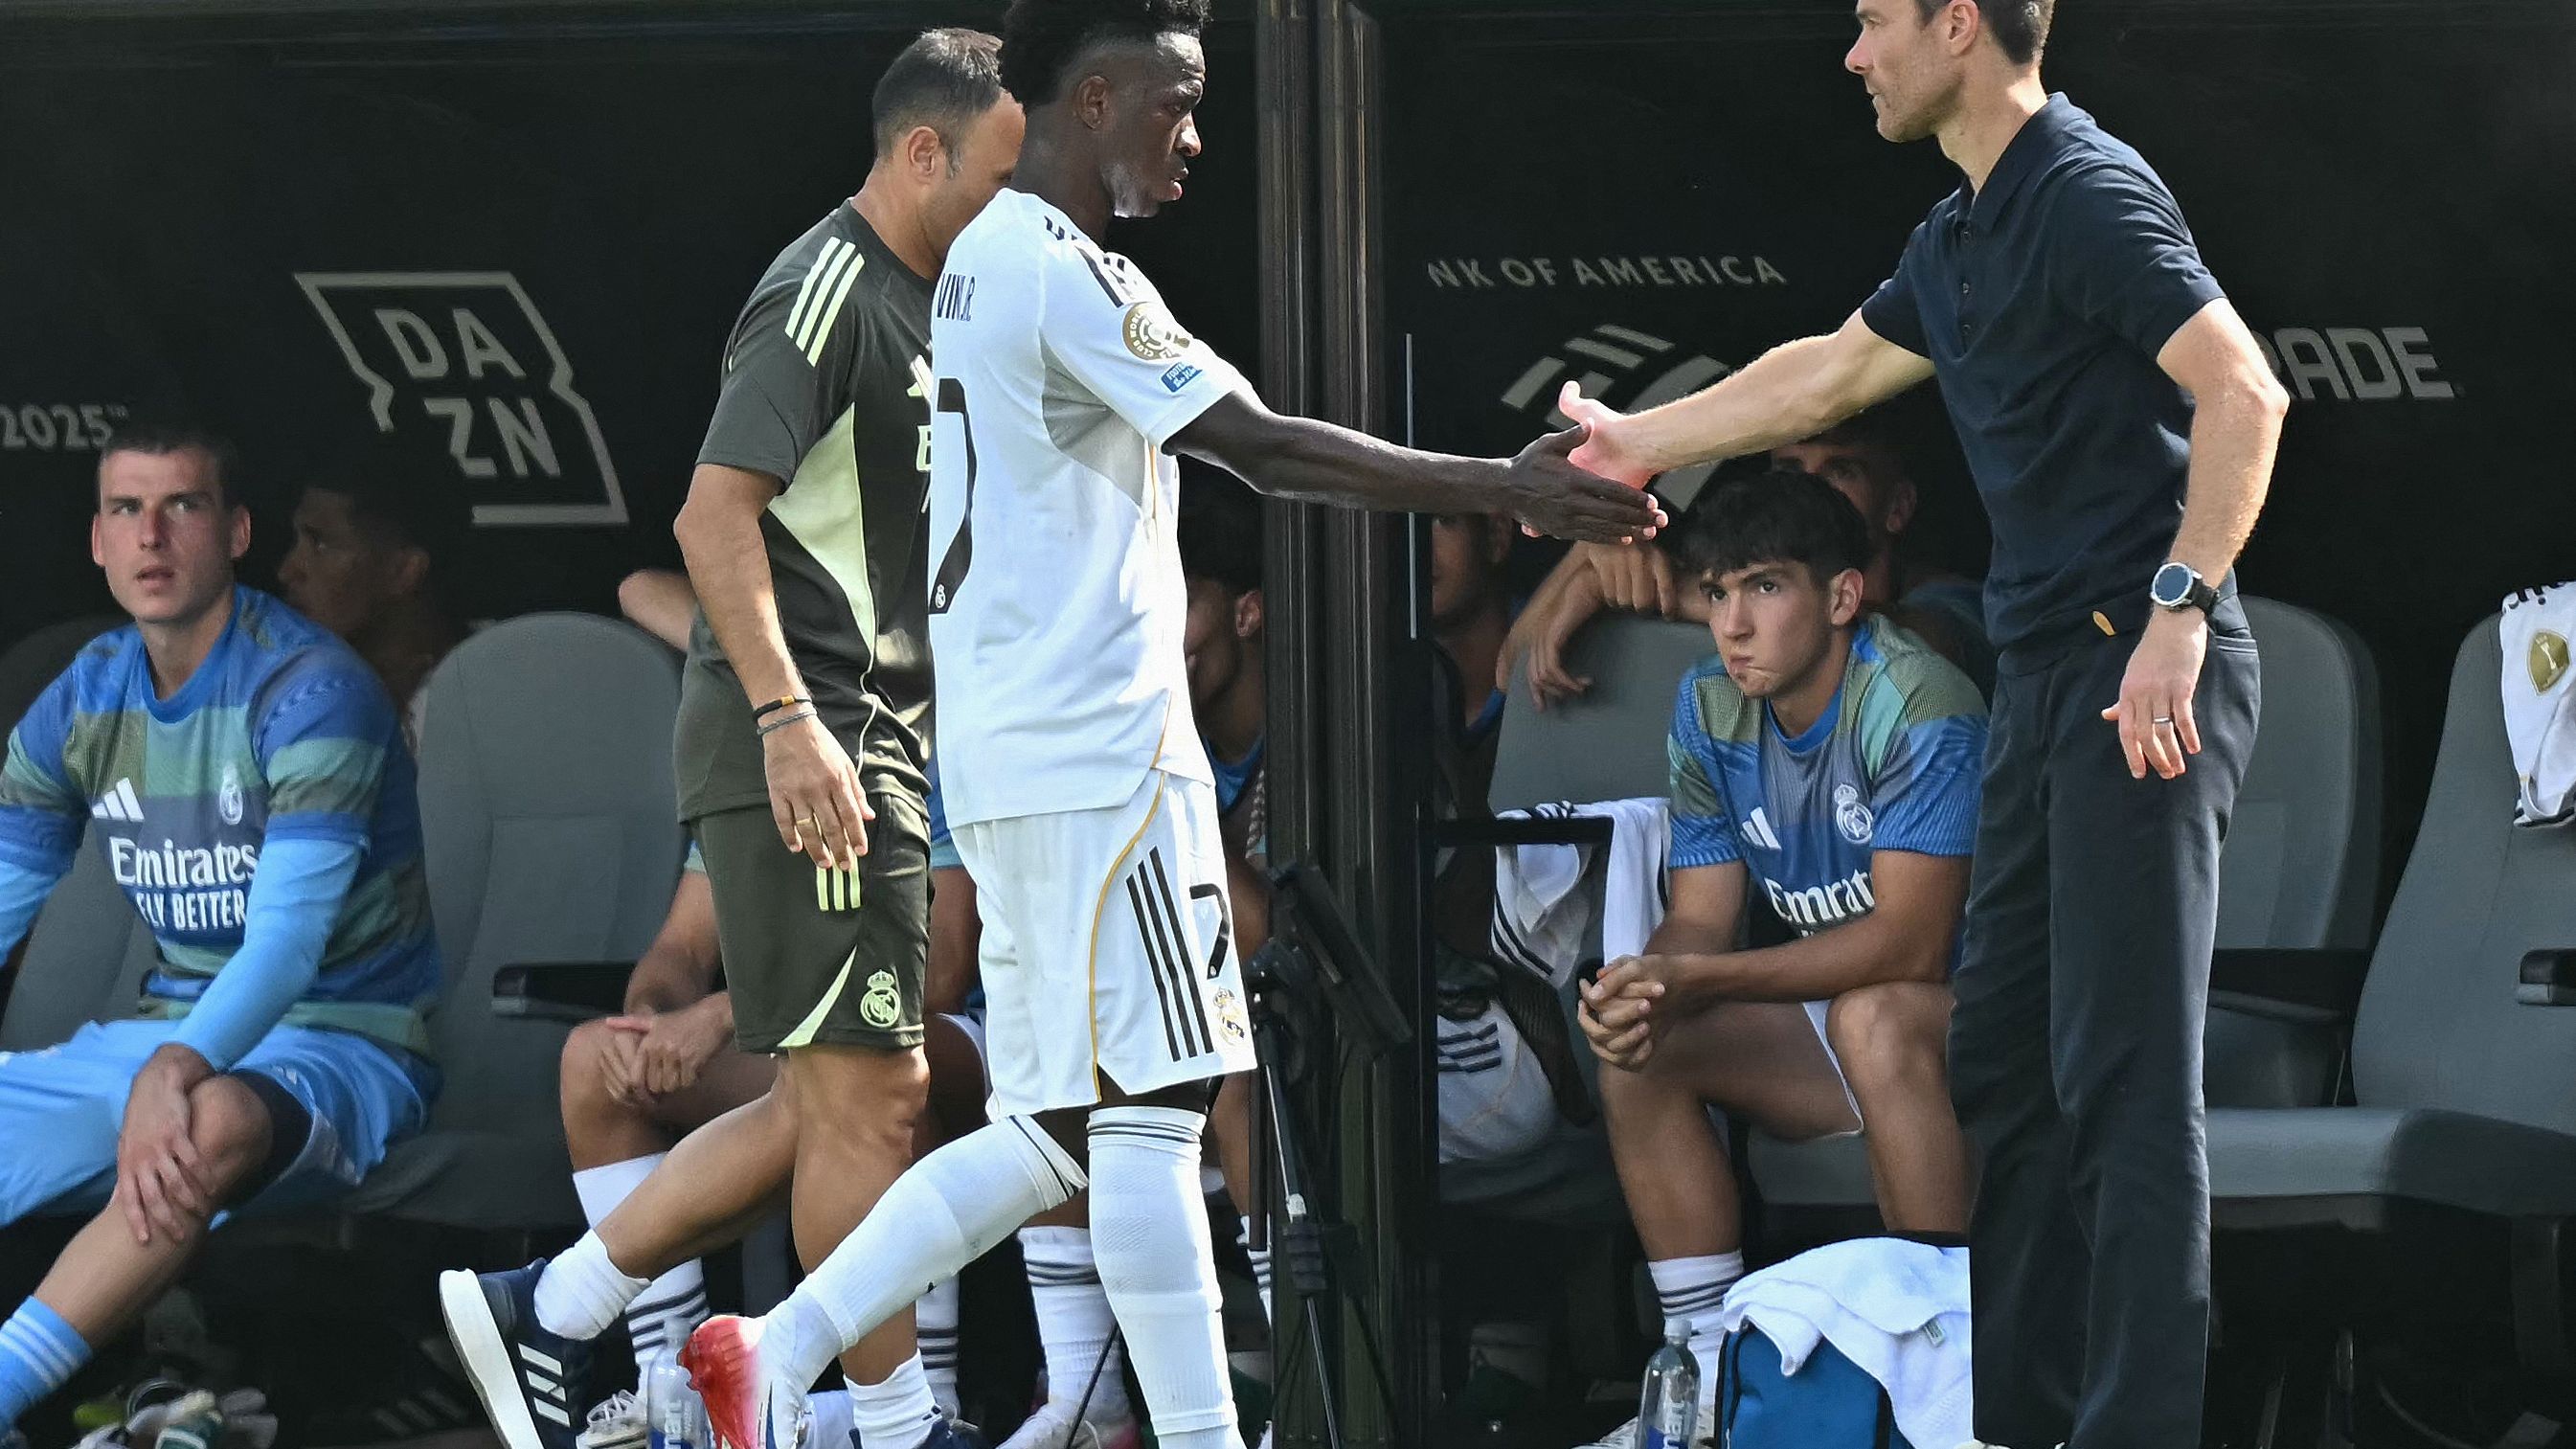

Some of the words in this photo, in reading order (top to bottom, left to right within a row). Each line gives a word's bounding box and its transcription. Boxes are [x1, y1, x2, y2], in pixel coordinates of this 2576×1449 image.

[1500, 258, 1557, 286] OF
[1572, 256, 1787, 286] AMERICA
[374, 307, 527, 378] DA
[2251, 327, 2455, 399] ADE
[422, 397, 561, 476] ZN
[109, 836, 258, 888] Emirates
[171, 889, 246, 931] BETTER
[1189, 896, 1231, 980] 7
